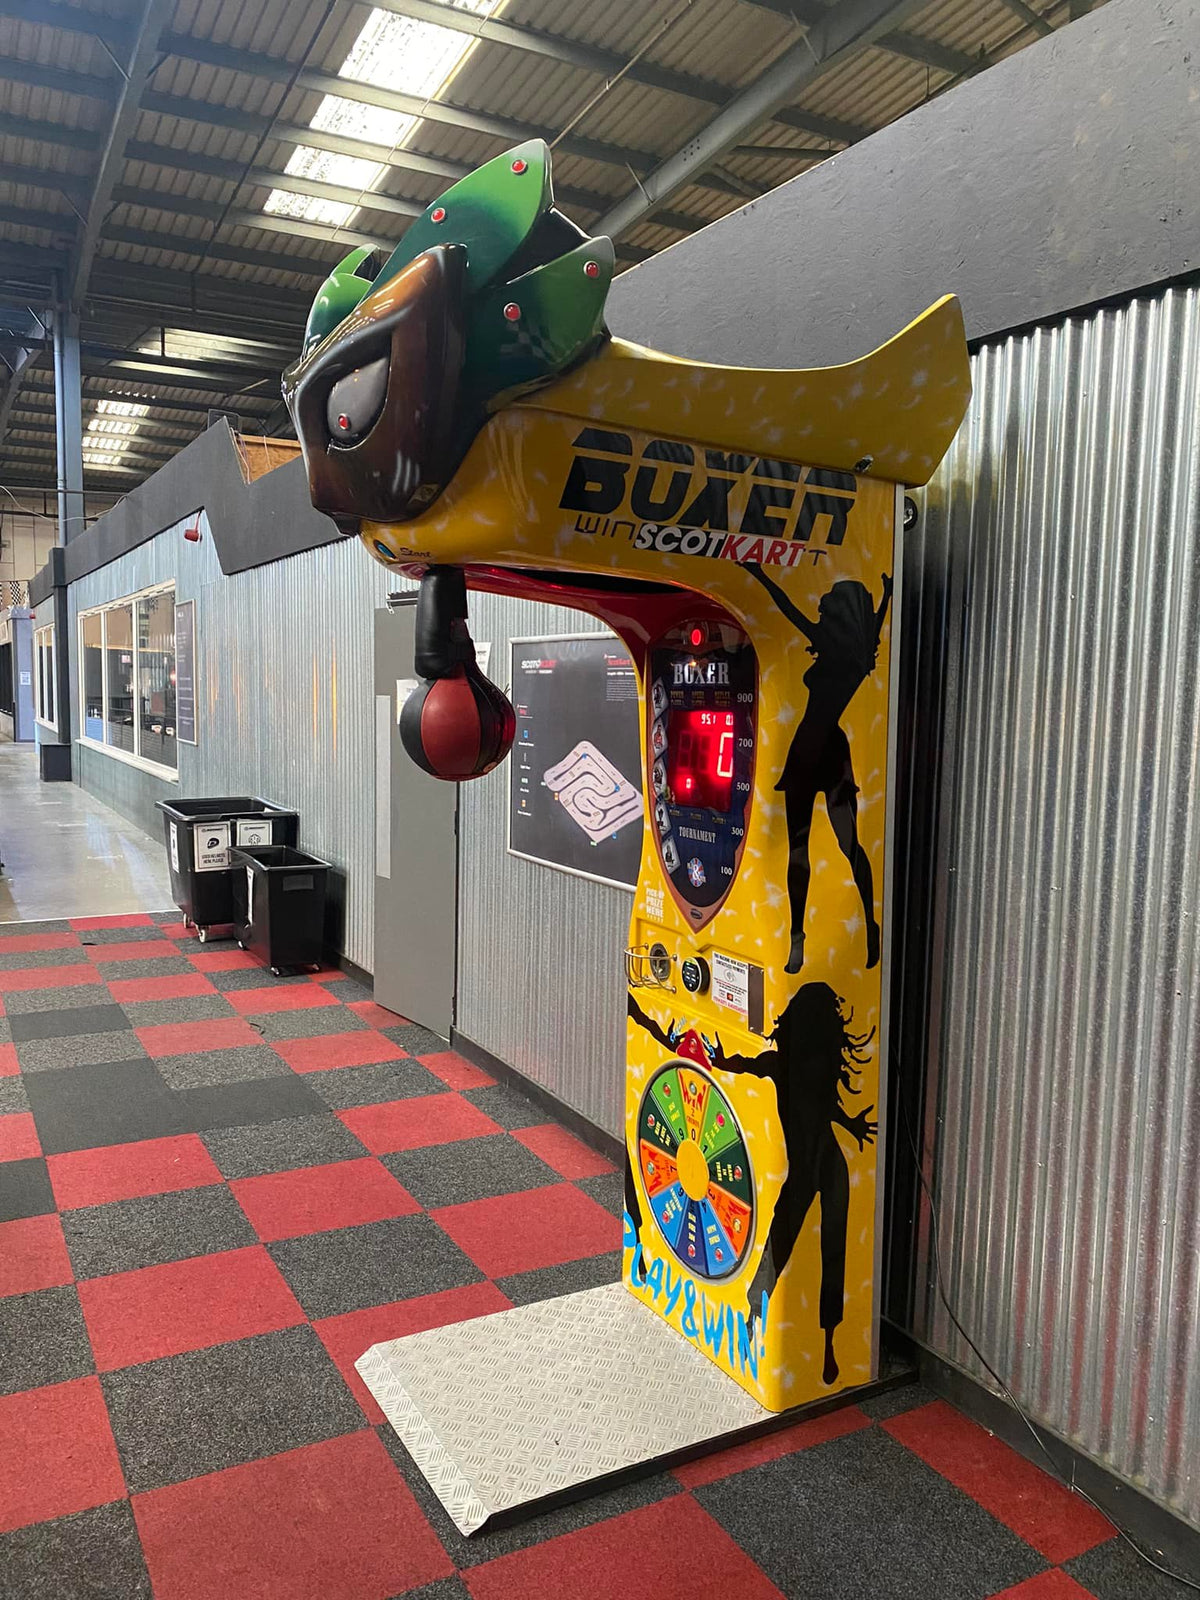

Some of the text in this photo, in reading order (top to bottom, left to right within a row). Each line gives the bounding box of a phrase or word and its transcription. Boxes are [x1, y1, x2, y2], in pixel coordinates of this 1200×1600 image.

[558, 427, 857, 545] BOXER
[635, 523, 806, 568] SCOTKART
[673, 662, 730, 685] BOXER
[737, 692, 753, 703] 900
[738, 738, 753, 748] 700
[736, 782, 750, 791] 500
[679, 826, 716, 844] TOURNAMENT
[731, 826, 744, 836] 300
[720, 865, 733, 875] 100
